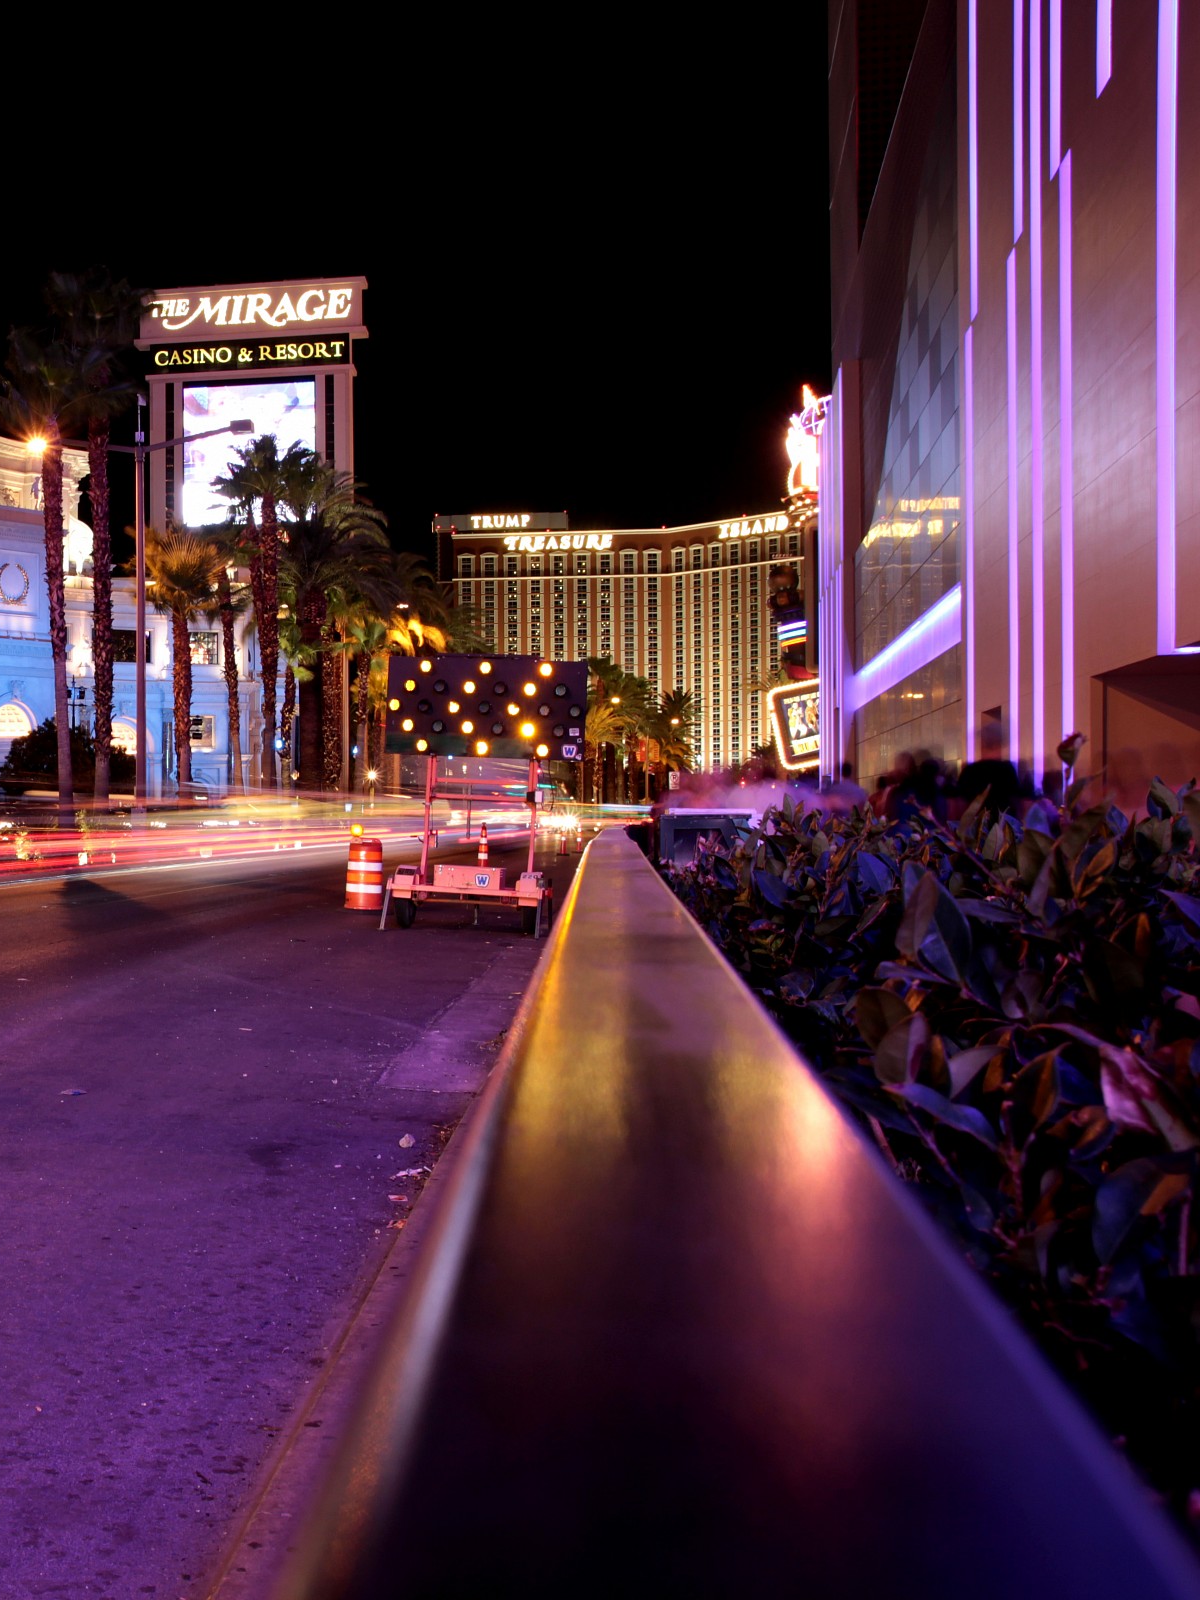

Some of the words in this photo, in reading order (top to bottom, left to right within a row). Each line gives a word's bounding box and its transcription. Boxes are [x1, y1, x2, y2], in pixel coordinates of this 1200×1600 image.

[147, 298, 190, 318] THE
[162, 288, 353, 330] MIRAGE
[154, 347, 232, 366] CASINO
[237, 348, 253, 363] &
[258, 341, 345, 361] RESORT
[470, 514, 531, 529] TRUMP
[503, 534, 613, 552] TREASURE
[718, 515, 789, 539] ISLAND
[563, 745, 576, 757] W
[476, 875, 488, 886] W
